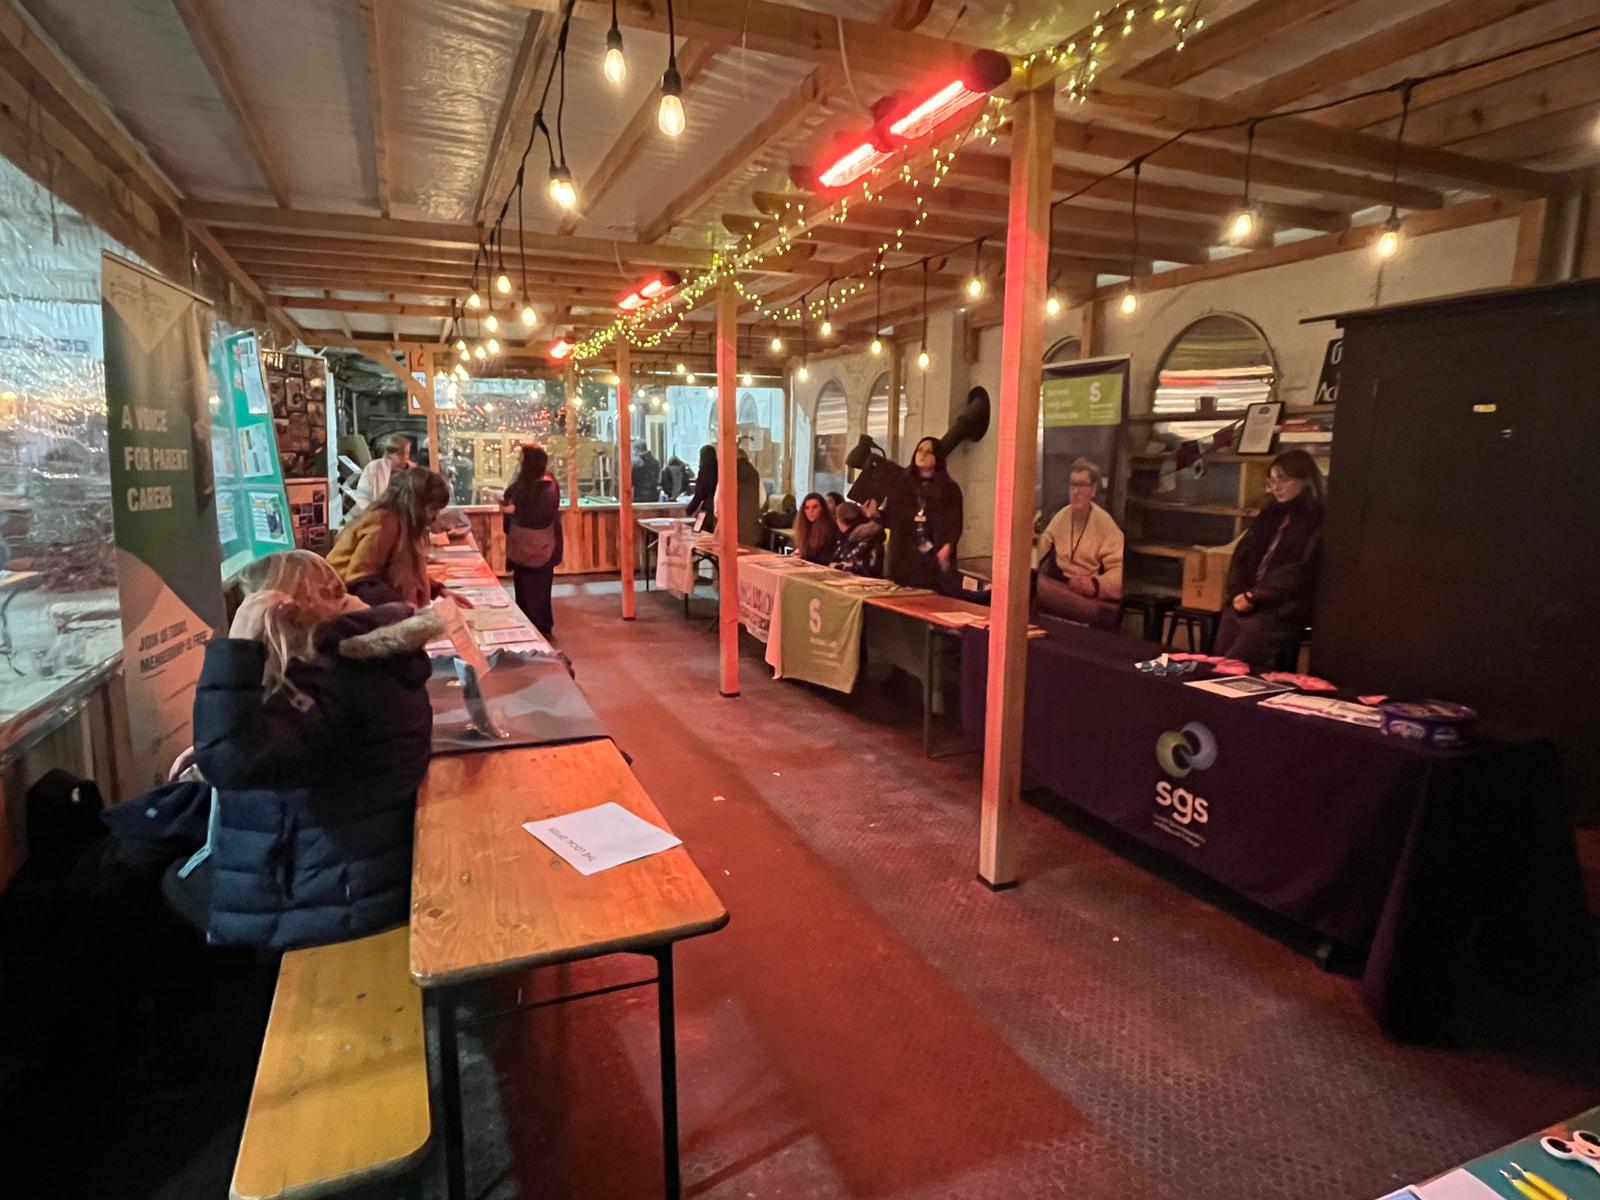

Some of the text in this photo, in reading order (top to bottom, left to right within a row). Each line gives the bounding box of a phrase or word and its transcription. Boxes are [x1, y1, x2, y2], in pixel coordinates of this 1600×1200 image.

[121, 405, 168, 432] A VOICE
[124, 446, 188, 471] FOR PARENT
[127, 486, 172, 512] CARERS
[809, 598, 822, 633] S
[1155, 780, 1209, 825] sgs
